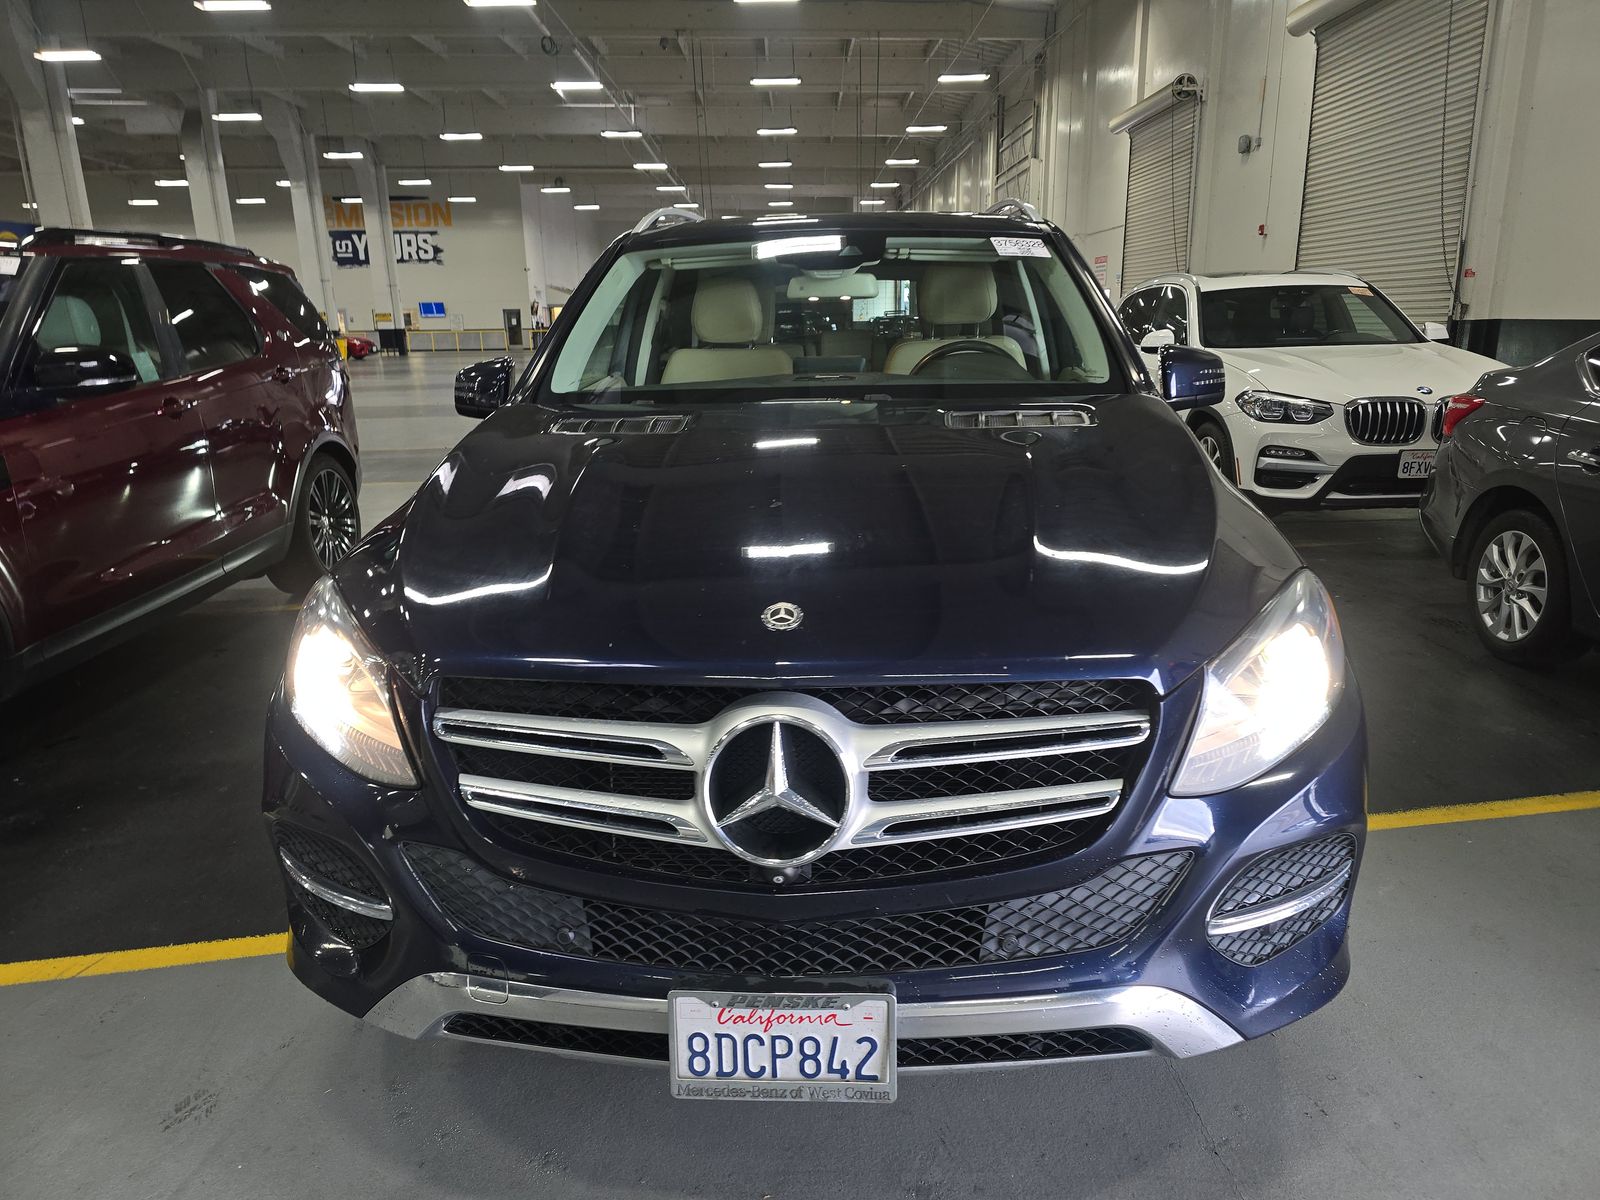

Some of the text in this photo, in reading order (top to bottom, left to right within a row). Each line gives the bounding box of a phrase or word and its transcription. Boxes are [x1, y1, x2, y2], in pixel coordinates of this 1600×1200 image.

[335, 201, 453, 228] MSION
[335, 233, 435, 261] IS YRS
[1402, 461, 1431, 474] 8FXV
[726, 994, 841, 1009] PENSKE
[716, 1007, 853, 1033] California
[687, 1032, 879, 1081] 8DCP842
[676, 1083, 891, 1100] Mercedes-Benz of West Covina
